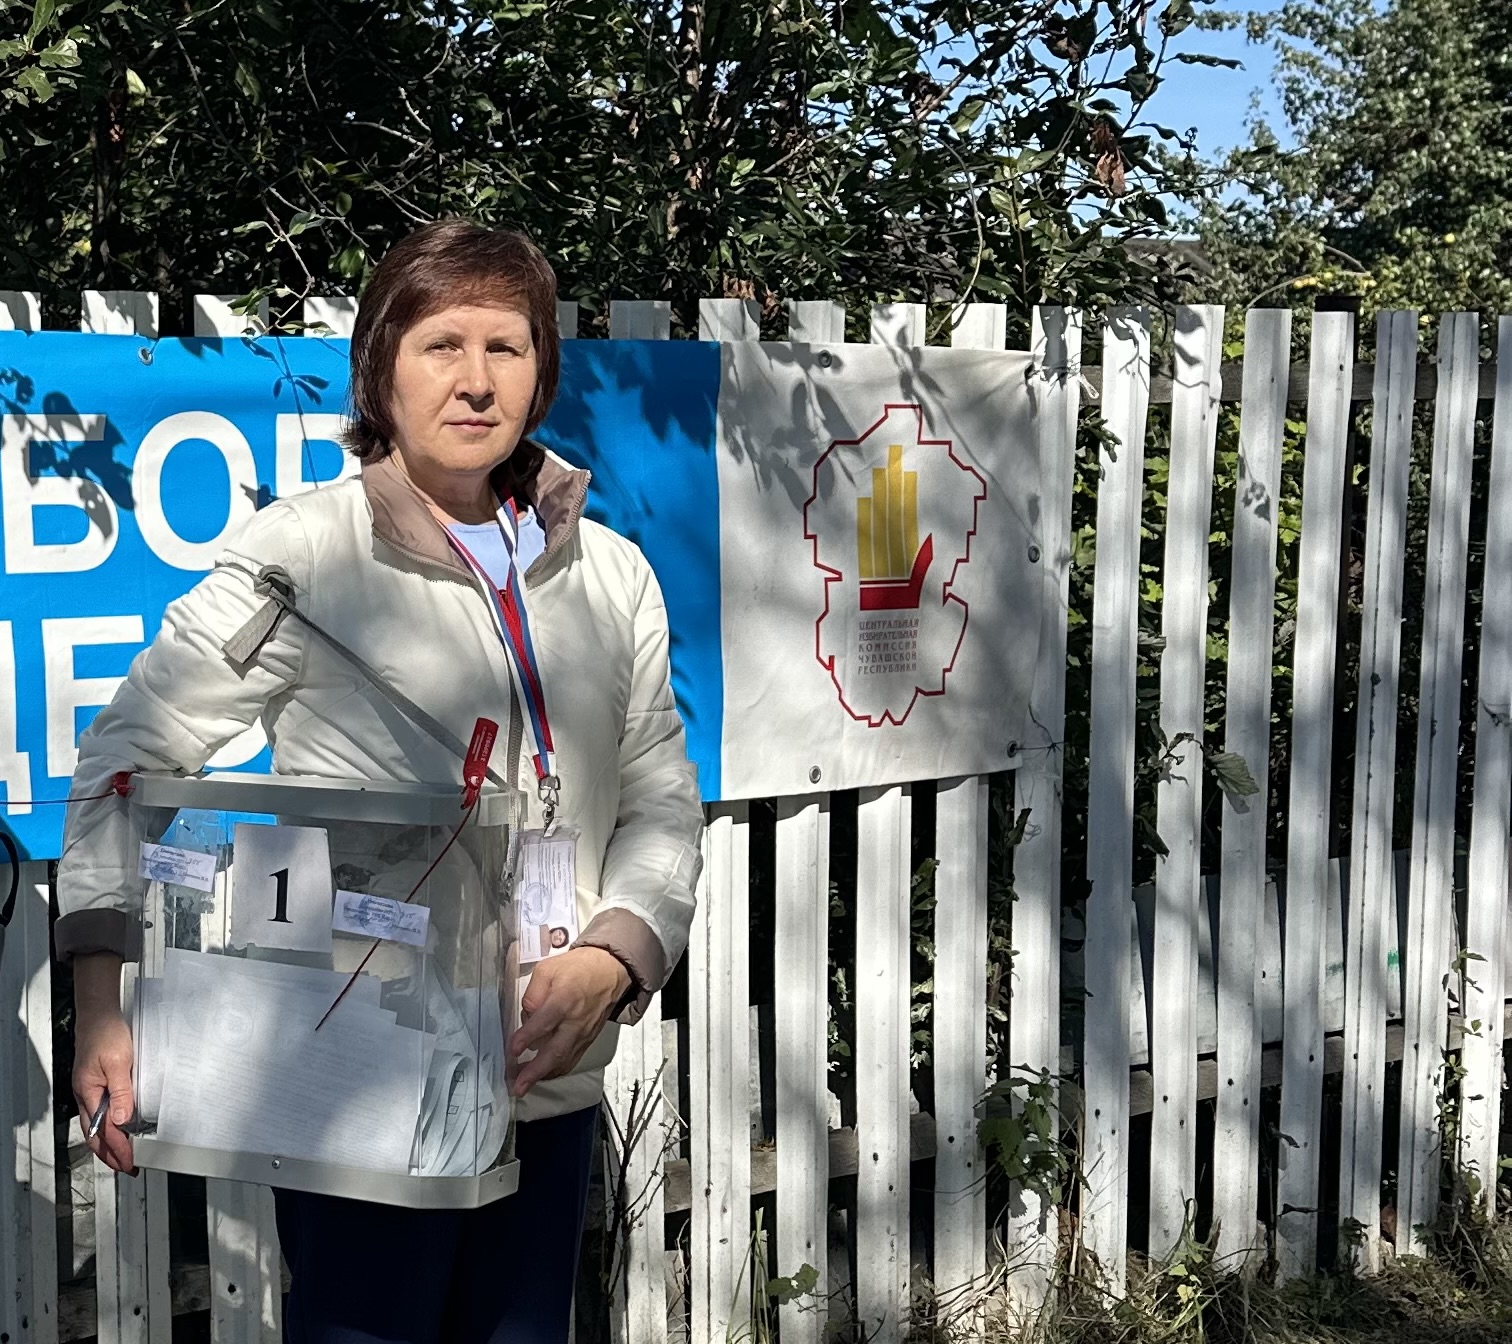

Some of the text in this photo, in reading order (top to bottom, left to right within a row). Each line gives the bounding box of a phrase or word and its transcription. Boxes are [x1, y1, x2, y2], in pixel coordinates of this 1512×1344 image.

[859, 618, 919, 630] ЦЕНТРАЛЬНАЯ
[858, 640, 917, 652] КОМИССИЯ
[858, 651, 917, 663] ЧУВАШСКОЙ
[858, 662, 917, 675] РЕСПУБЛИКИ
[267, 867, 294, 924] 1
